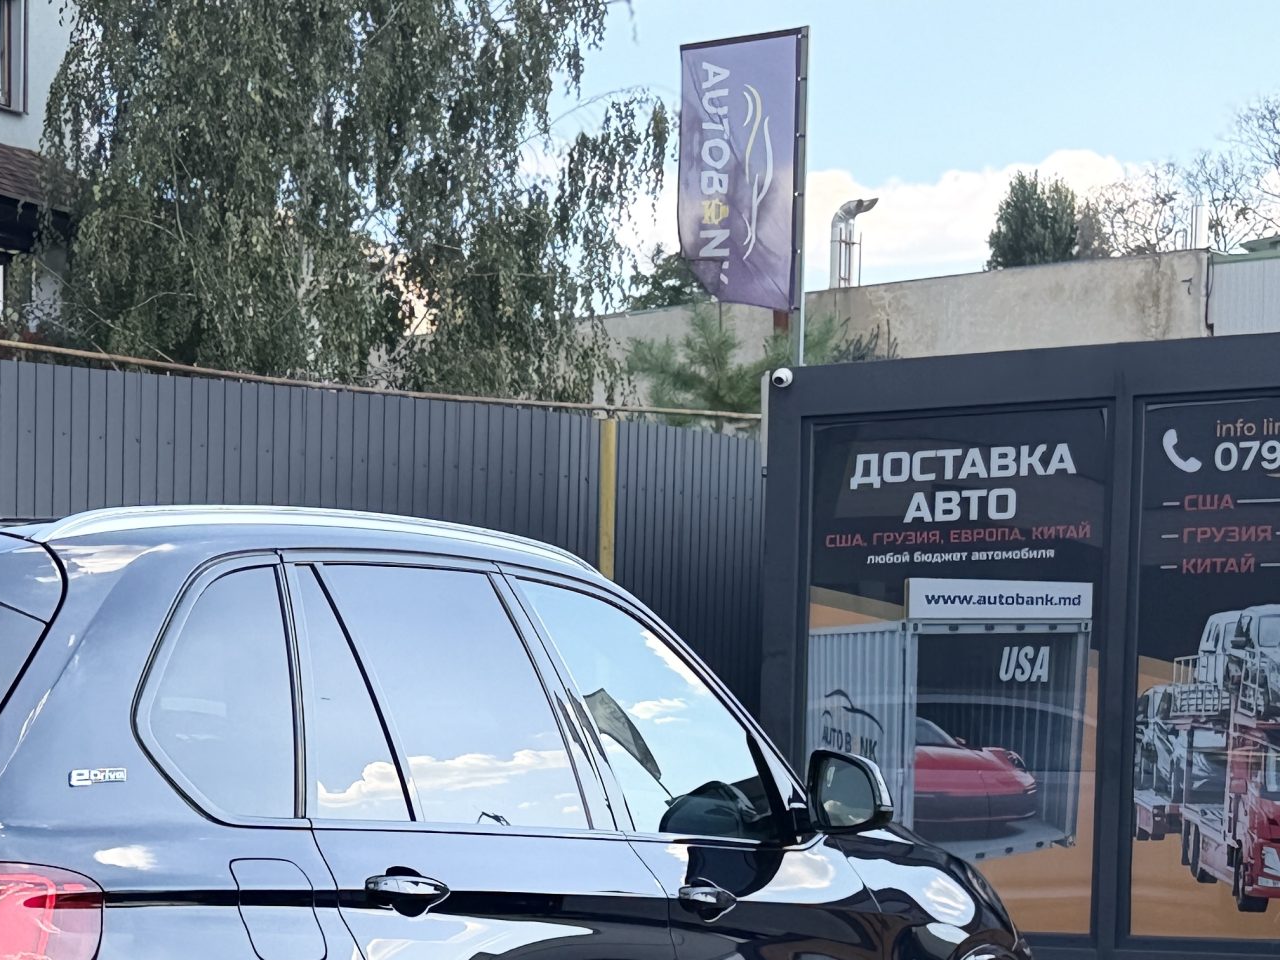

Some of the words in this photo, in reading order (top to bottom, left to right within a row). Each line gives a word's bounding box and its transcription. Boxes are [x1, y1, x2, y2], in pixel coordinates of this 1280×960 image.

[699, 61, 731, 286] AUTOBN
[1216, 419, 1256, 437] info
[850, 443, 1077, 490] ДОСТАВКА
[1214, 440, 1280, 472] 079
[903, 488, 1017, 523] АВТО
[1184, 494, 1234, 511] США
[872, 529, 944, 545] ГРУЗИЯ,
[1032, 520, 1091, 540] КИТАЙ
[1182, 525, 1273, 543] ГРУЗИЯ
[867, 551, 910, 564] любой
[913, 551, 968, 564] бюджет
[971, 547, 1055, 561] автомобиля
[1182, 553, 1256, 574] КИТАЙ
[924, 592, 1082, 607] www.autobank.md
[998, 646, 1050, 683] USA
[822, 725, 878, 763] AUTOBNK
